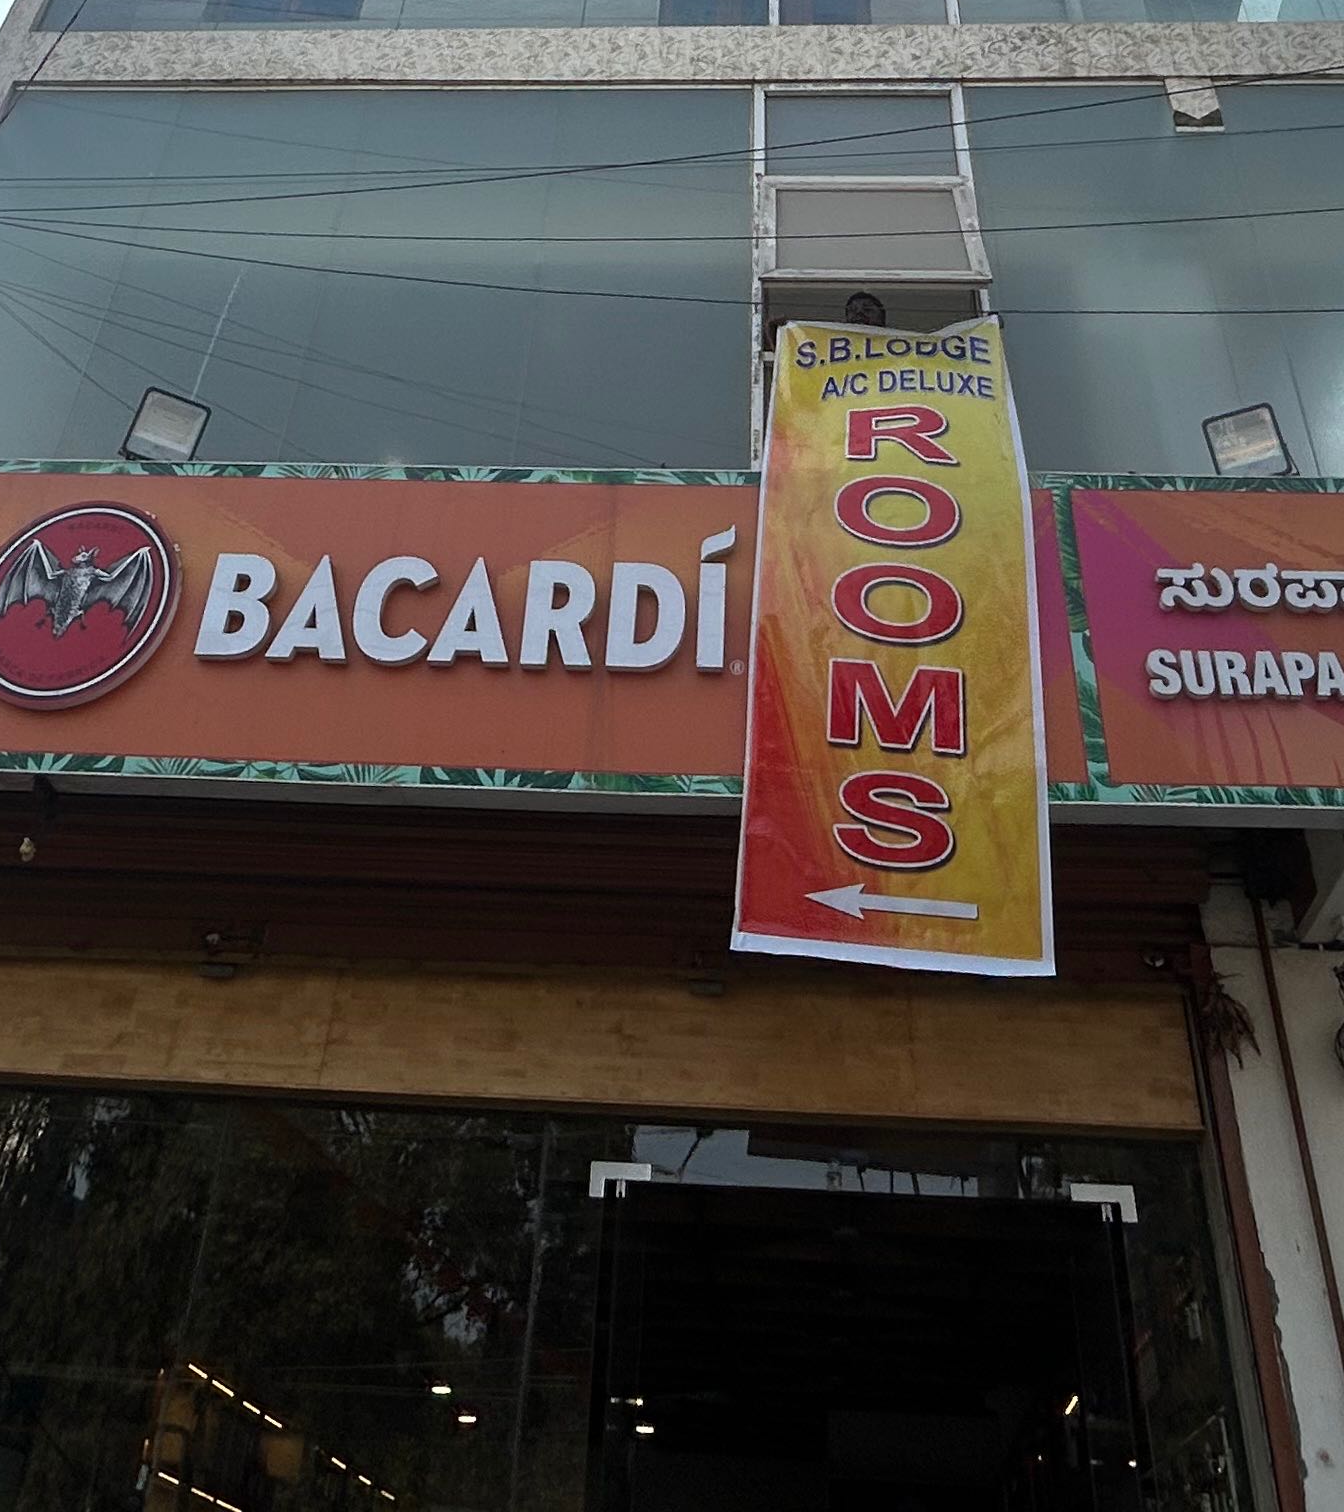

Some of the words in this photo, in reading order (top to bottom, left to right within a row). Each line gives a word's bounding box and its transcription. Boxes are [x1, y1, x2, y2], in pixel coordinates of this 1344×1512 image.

[821, 370, 869, 400] A/C
[878, 370, 995, 401] DELUXE
[826, 405, 964, 870] ROOMS
